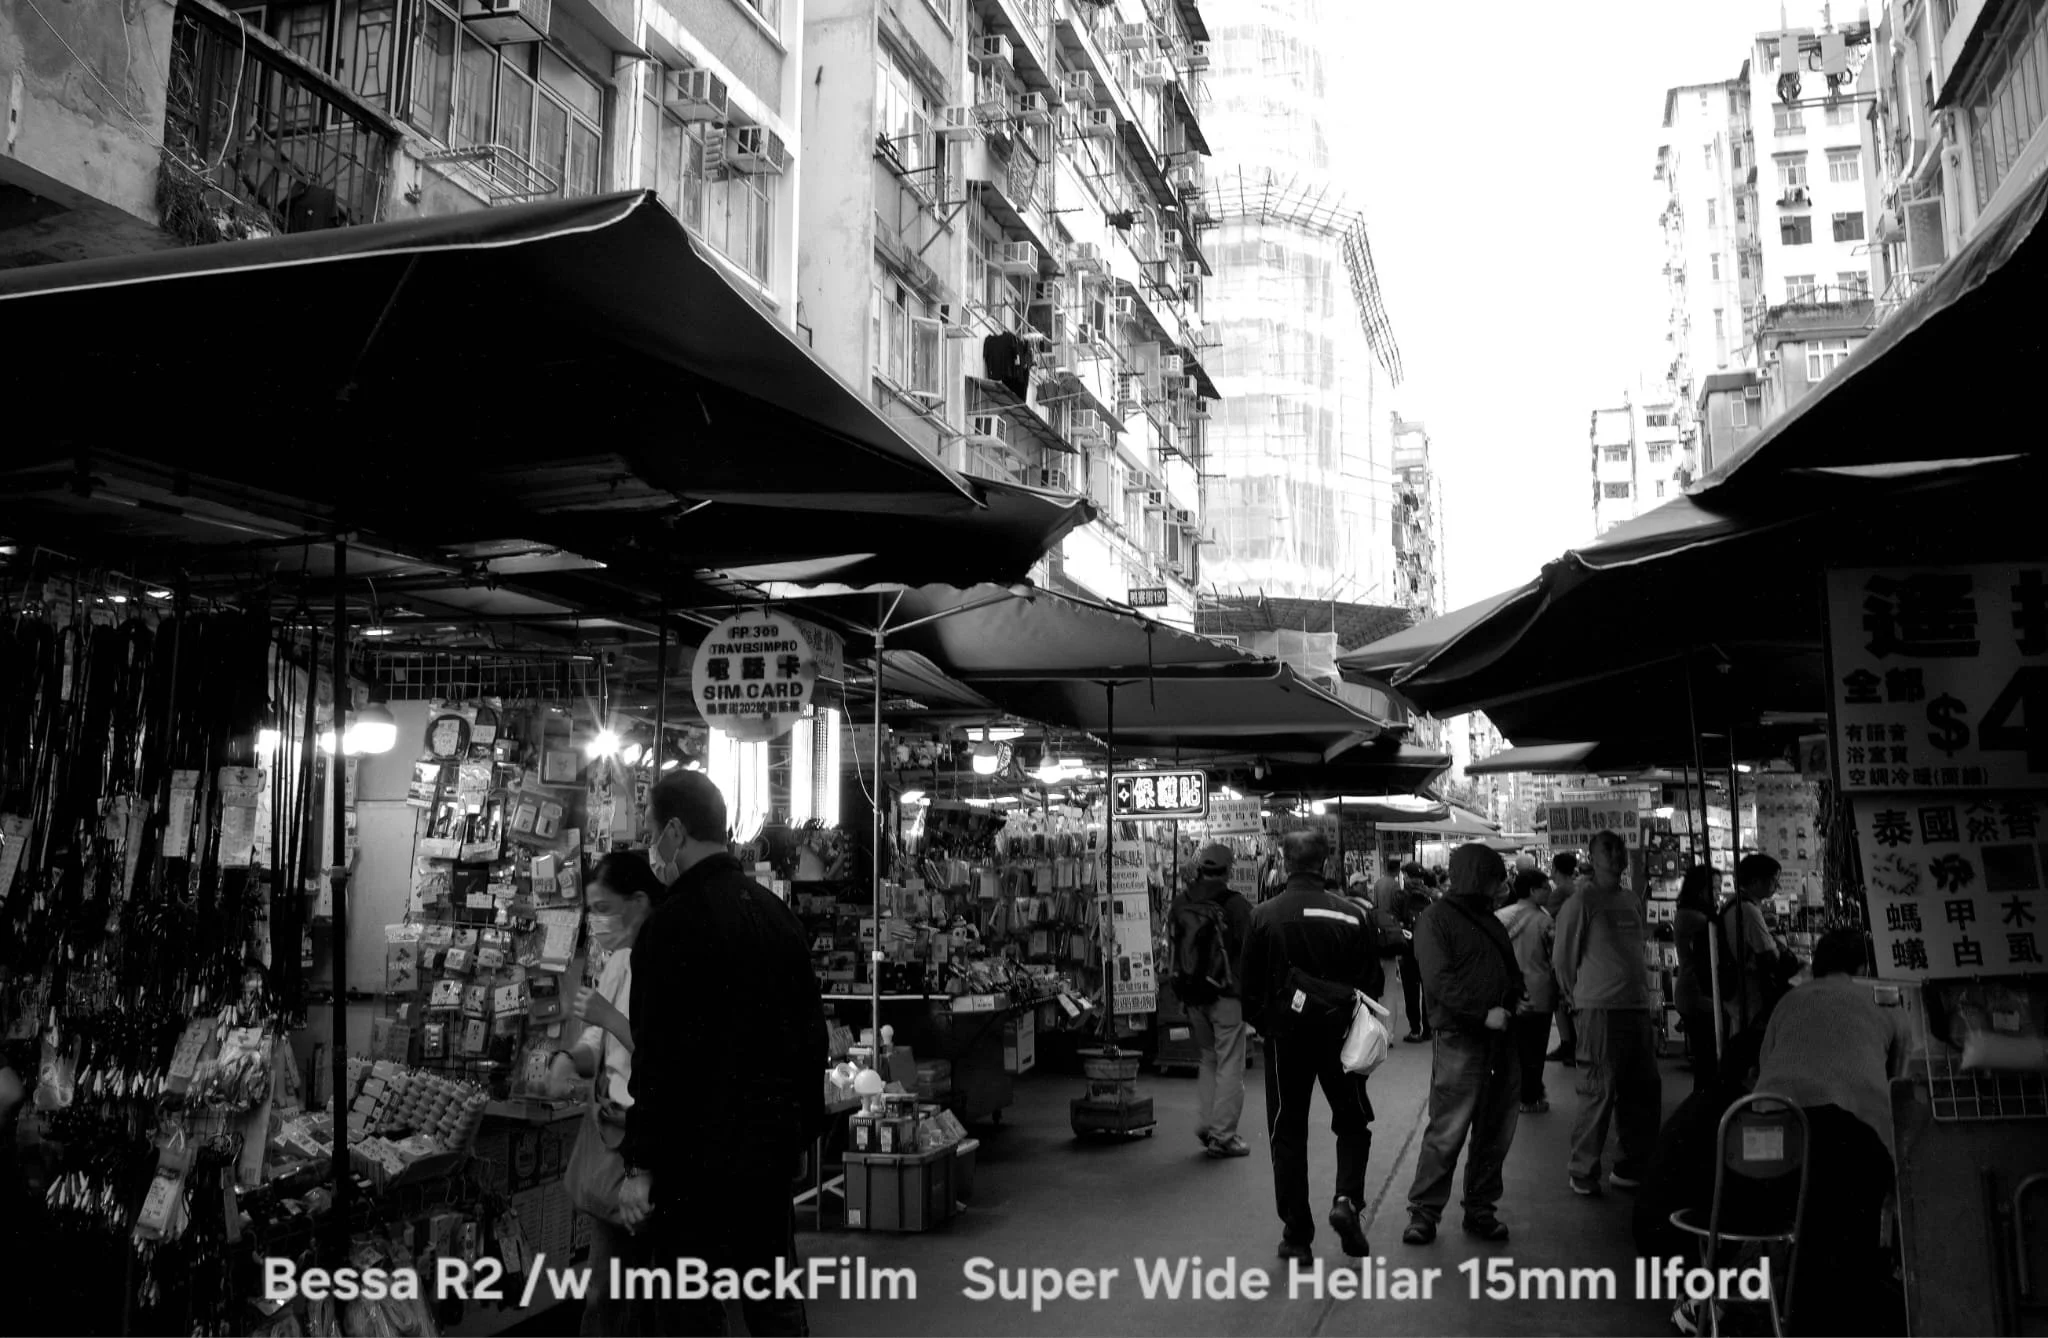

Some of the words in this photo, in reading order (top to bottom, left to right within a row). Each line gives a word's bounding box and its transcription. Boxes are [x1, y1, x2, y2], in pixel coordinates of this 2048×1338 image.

[706, 655, 801, 681] 電話卡
[703, 683, 741, 700] SIM
[746, 681, 804, 698] CARD
[1842, 666, 1926, 704] 全部
[1133, 775, 1202, 809] 保護貼
[1099, 879, 1145, 891] Potector
[1886, 902, 1929, 971] 螞蟻
[2001, 894, 2044, 964] 木虱
